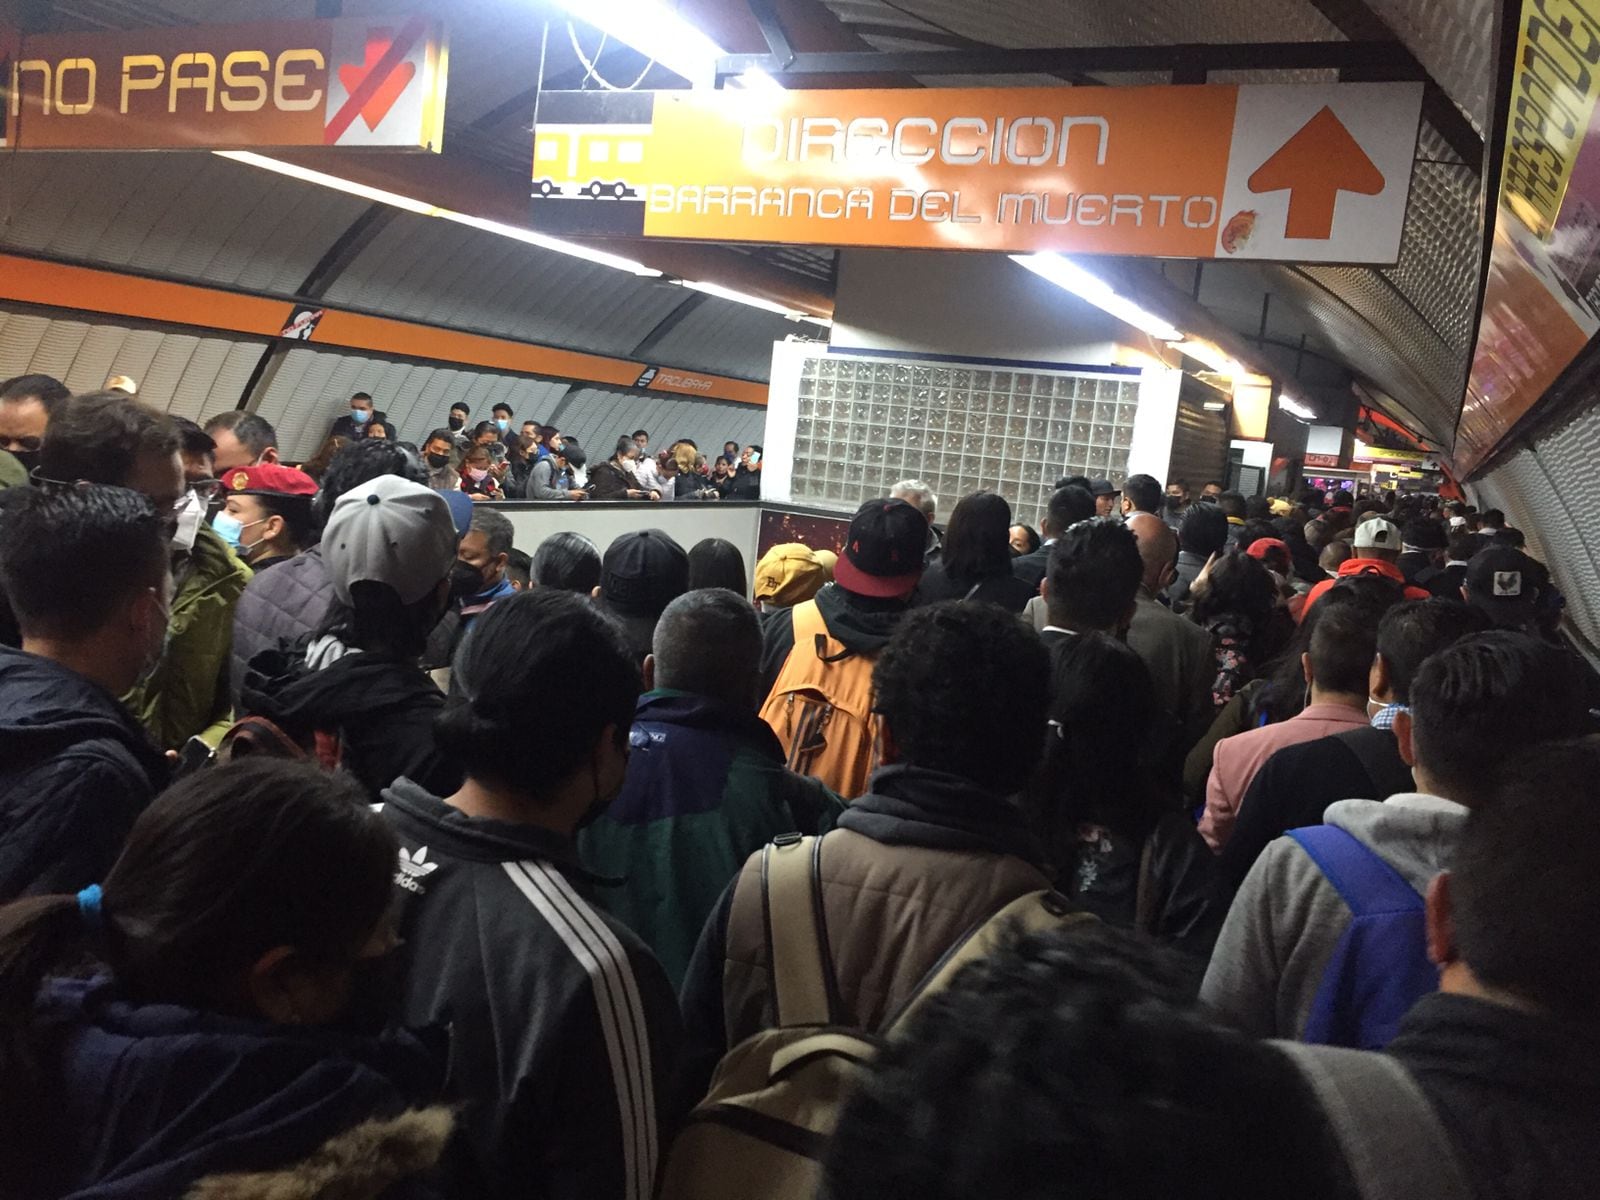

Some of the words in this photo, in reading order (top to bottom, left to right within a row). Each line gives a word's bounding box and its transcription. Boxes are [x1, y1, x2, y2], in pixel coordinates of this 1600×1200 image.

[12, 57, 97, 117] NO
[119, 48, 326, 115] PASE
[741, 115, 1110, 167] DIRECCION
[649, 183, 874, 220] BARRANCA
[888, 188, 982, 223] DEL
[997, 191, 1217, 228] MUERTO
[656, 374, 713, 391] TACUBAYA
